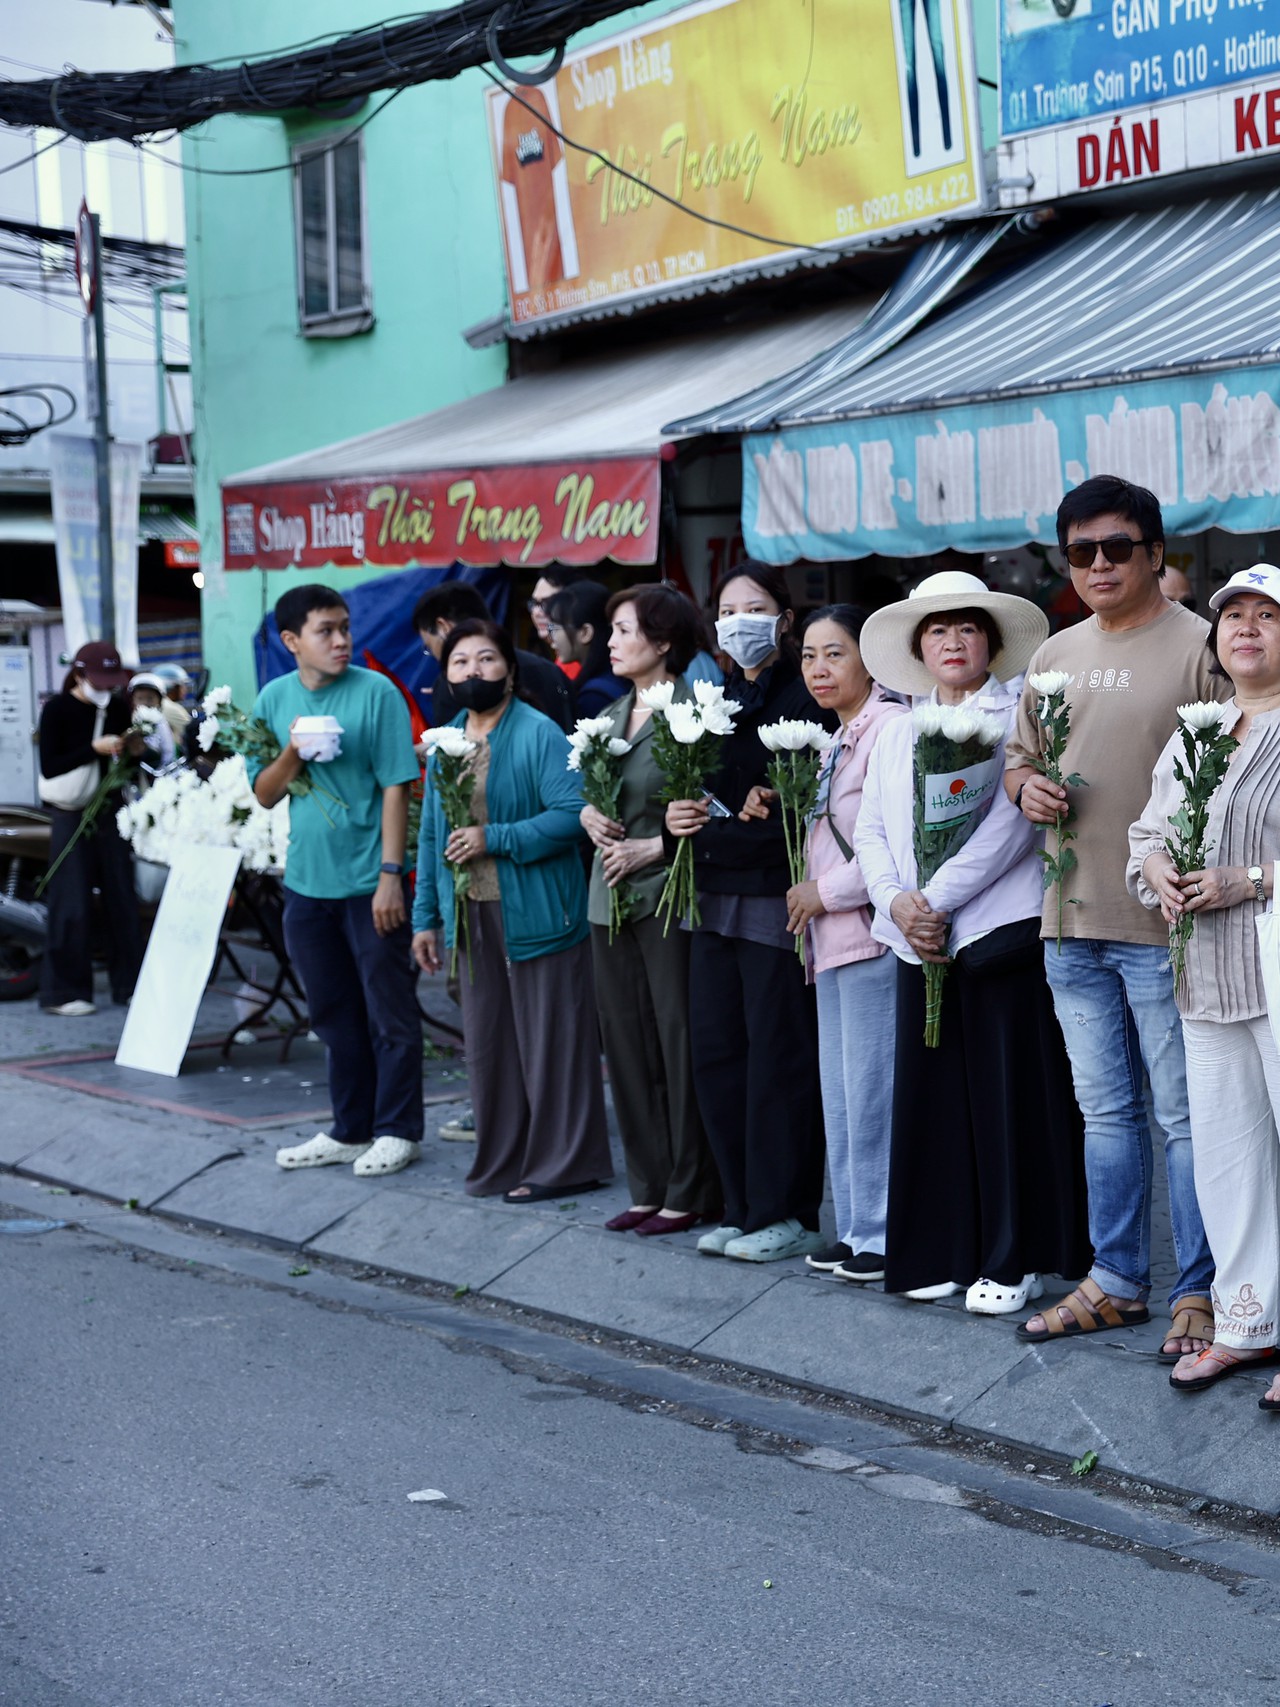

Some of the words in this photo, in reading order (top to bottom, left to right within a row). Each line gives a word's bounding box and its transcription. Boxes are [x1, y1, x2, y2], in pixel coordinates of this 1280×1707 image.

[571, 59, 617, 111] Shop
[1009, 89, 1028, 124] 01
[1093, 69, 1125, 105] Sơn
[1130, 55, 1168, 97] P15,
[1172, 44, 1208, 88] Q10
[660, 121, 763, 204] Trang
[770, 85, 863, 168] Nam
[1077, 115, 1160, 188] DÁN
[259, 505, 306, 562] Shop
[367, 484, 436, 548] Thời
[447, 479, 543, 563] Trang
[554, 472, 650, 544] Nam
[1077, 668, 1132, 689] 1982
